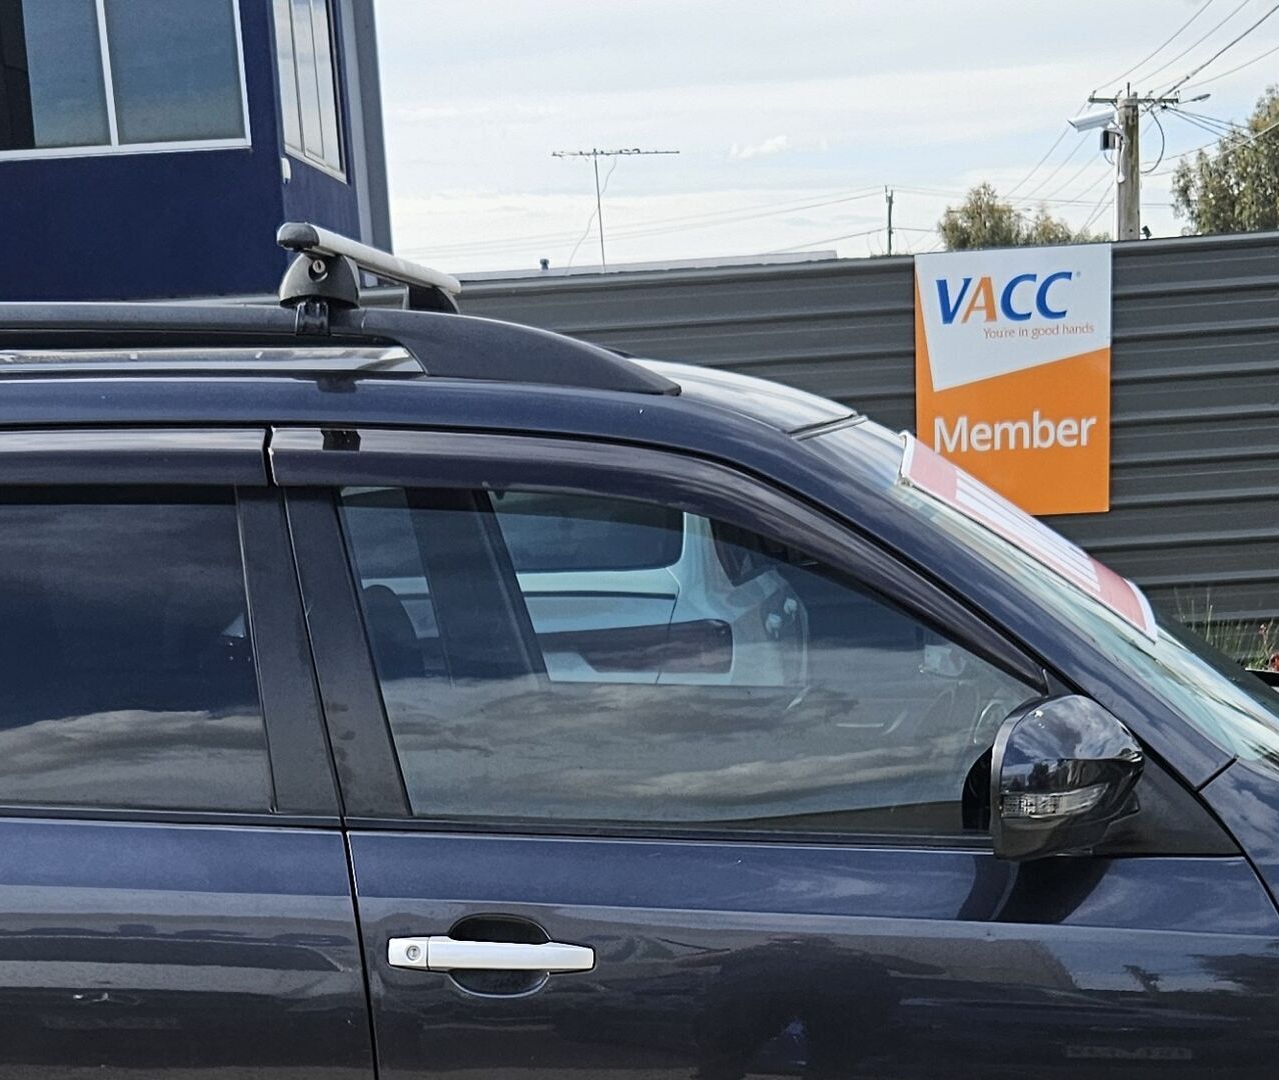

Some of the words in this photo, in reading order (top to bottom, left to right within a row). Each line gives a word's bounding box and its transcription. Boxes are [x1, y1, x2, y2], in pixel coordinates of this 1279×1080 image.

[935, 271, 1073, 325] VACC
[1018, 327, 1029, 338] in
[1031, 324, 1059, 340] good
[1062, 323, 1095, 335] hands
[934, 409, 1097, 455] Member
